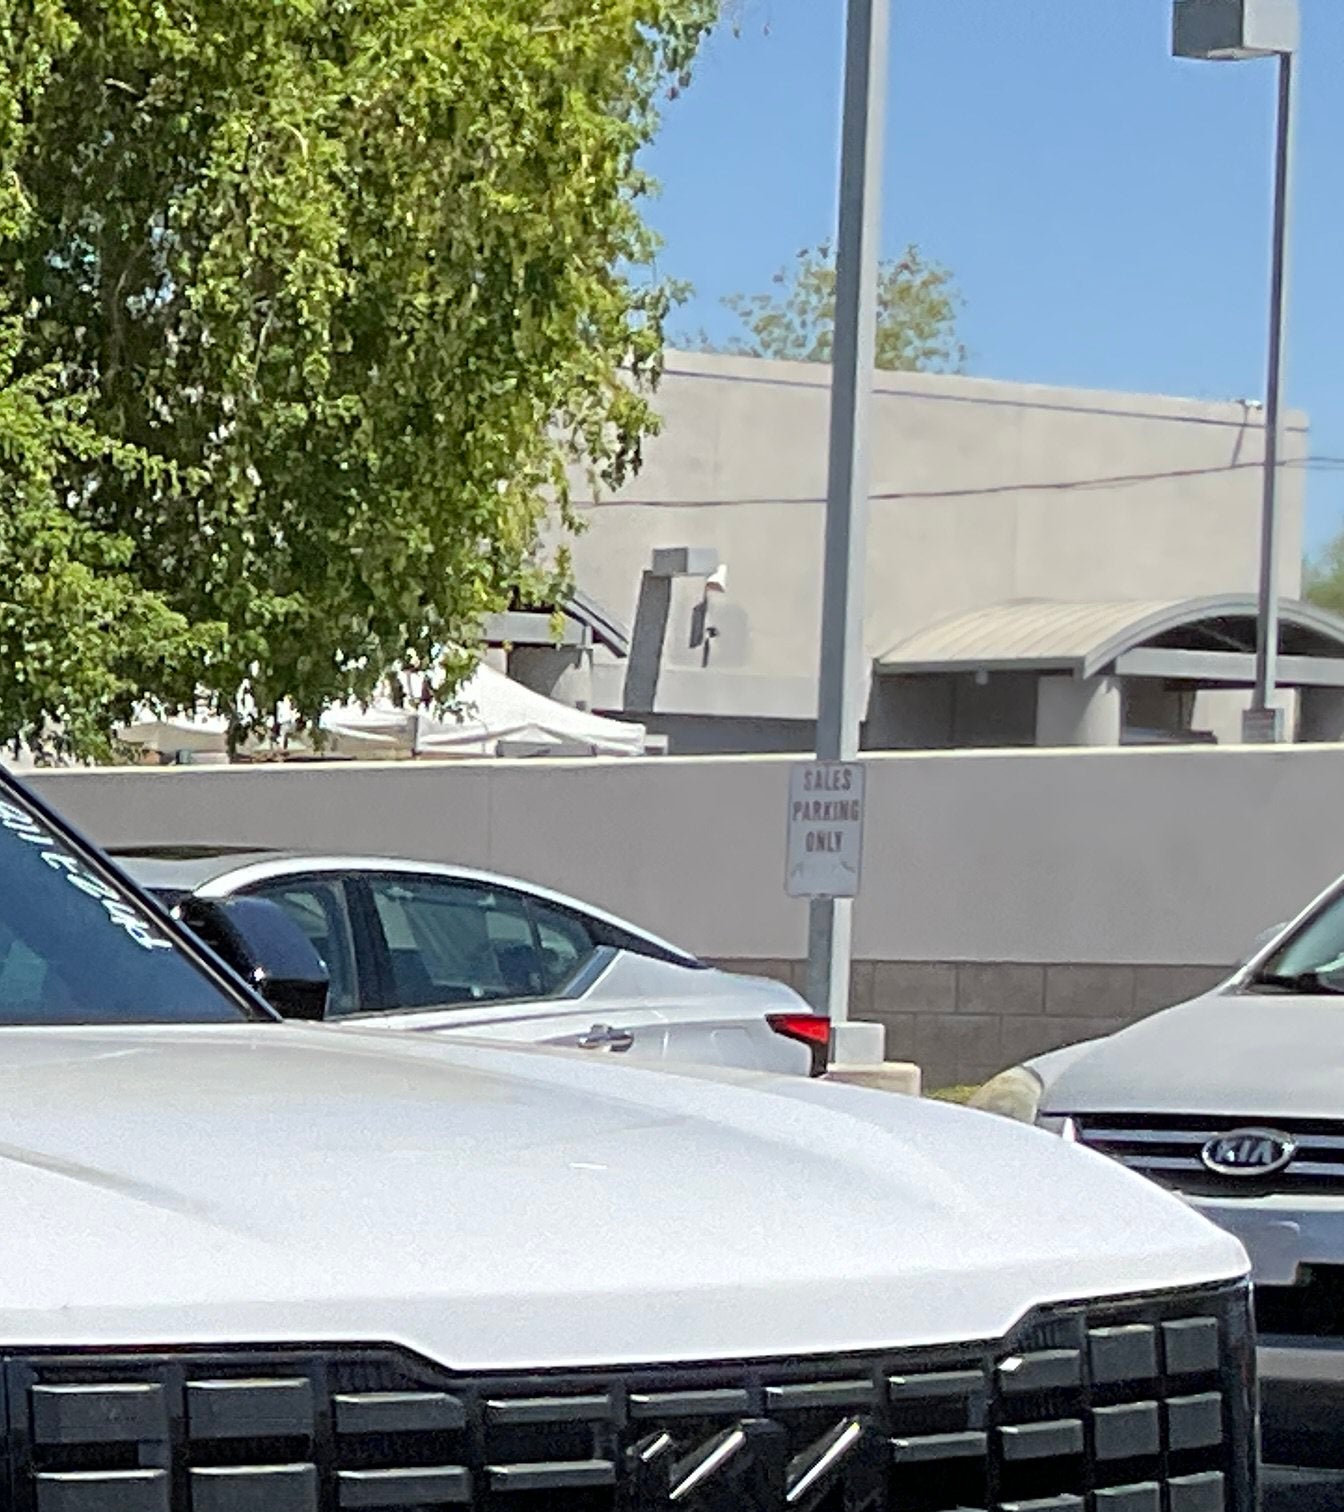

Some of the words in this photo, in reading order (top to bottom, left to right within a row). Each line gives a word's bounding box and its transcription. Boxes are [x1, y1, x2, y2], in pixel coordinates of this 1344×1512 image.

[803, 769, 853, 791] SALES
[792, 801, 859, 821] PARKING
[805, 831, 843, 852] ONLY
[1216, 1140, 1273, 1163] KIA
